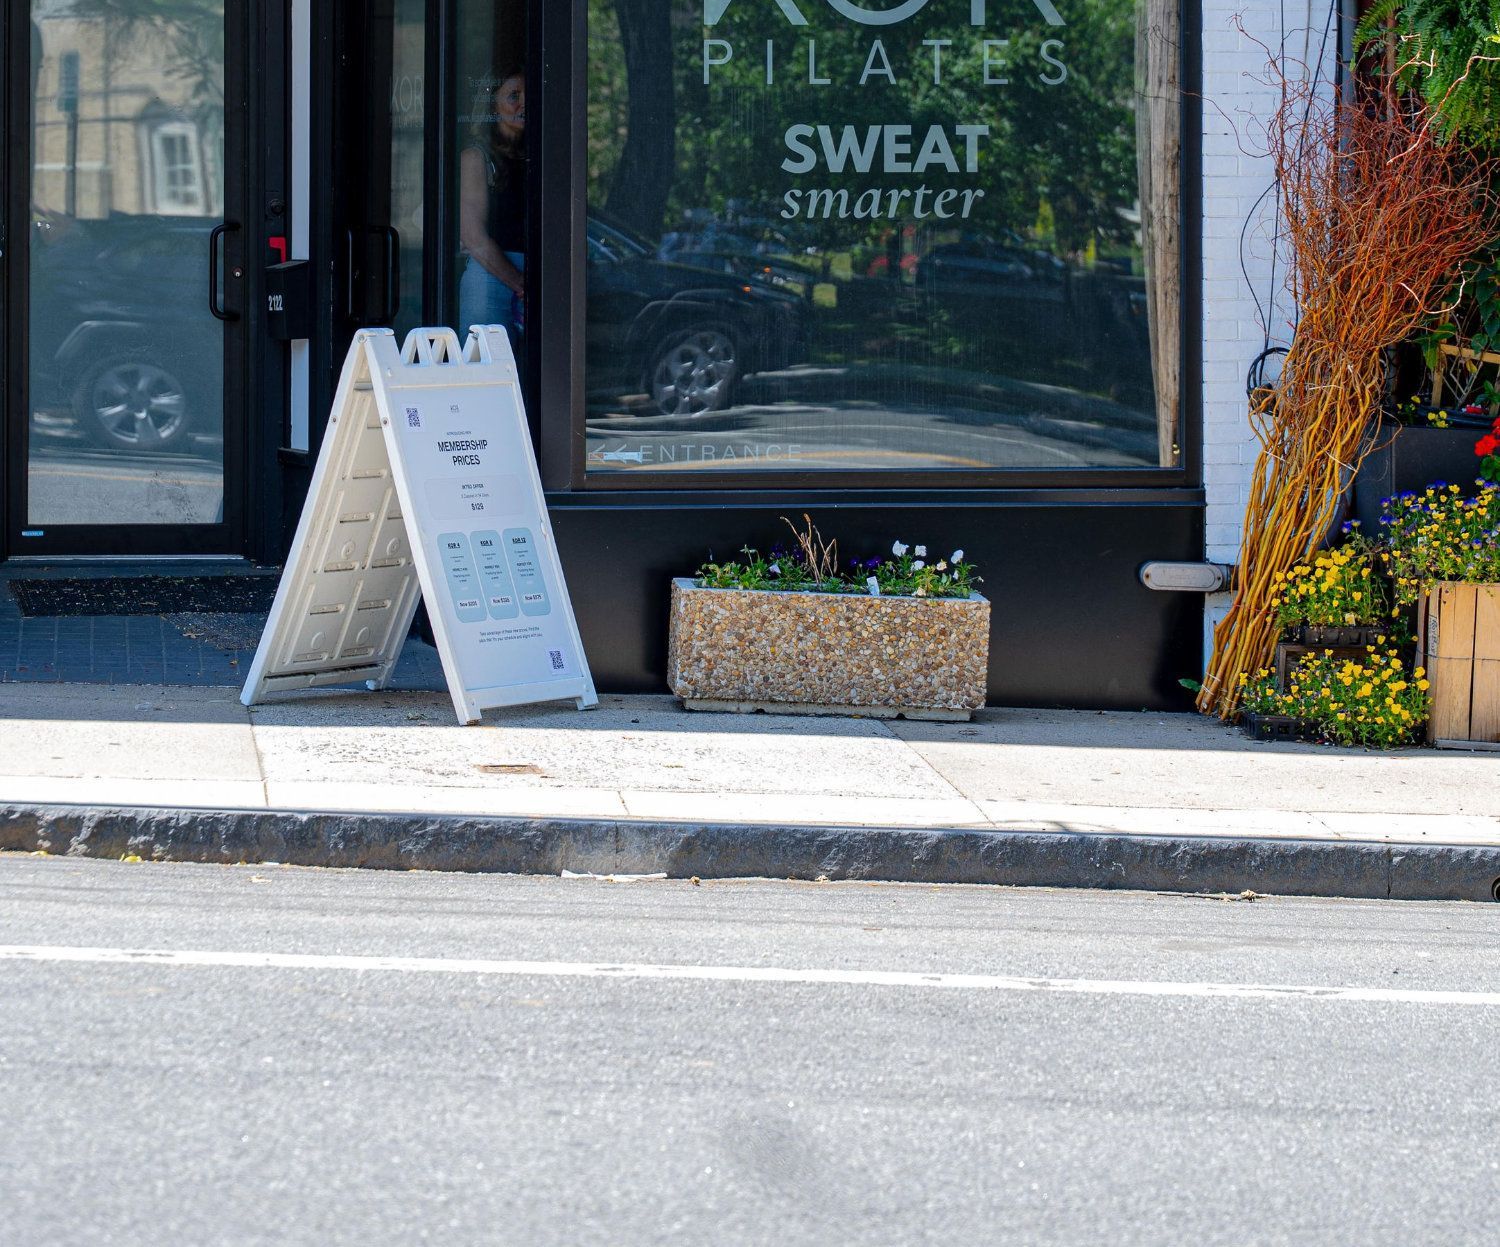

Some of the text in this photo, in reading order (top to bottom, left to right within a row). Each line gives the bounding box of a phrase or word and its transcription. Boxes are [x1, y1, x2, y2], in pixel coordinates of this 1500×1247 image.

[703, 38, 1069, 86] PILATES
[781, 124, 990, 174] SWEAT
[780, 182, 985, 220] smarter
[268, 294, 283, 311] 2122
[437, 439, 488, 452] MEMBERSHIP
[639, 444, 802, 462] ENTRANCE
[452, 454, 481, 466] PRICES
